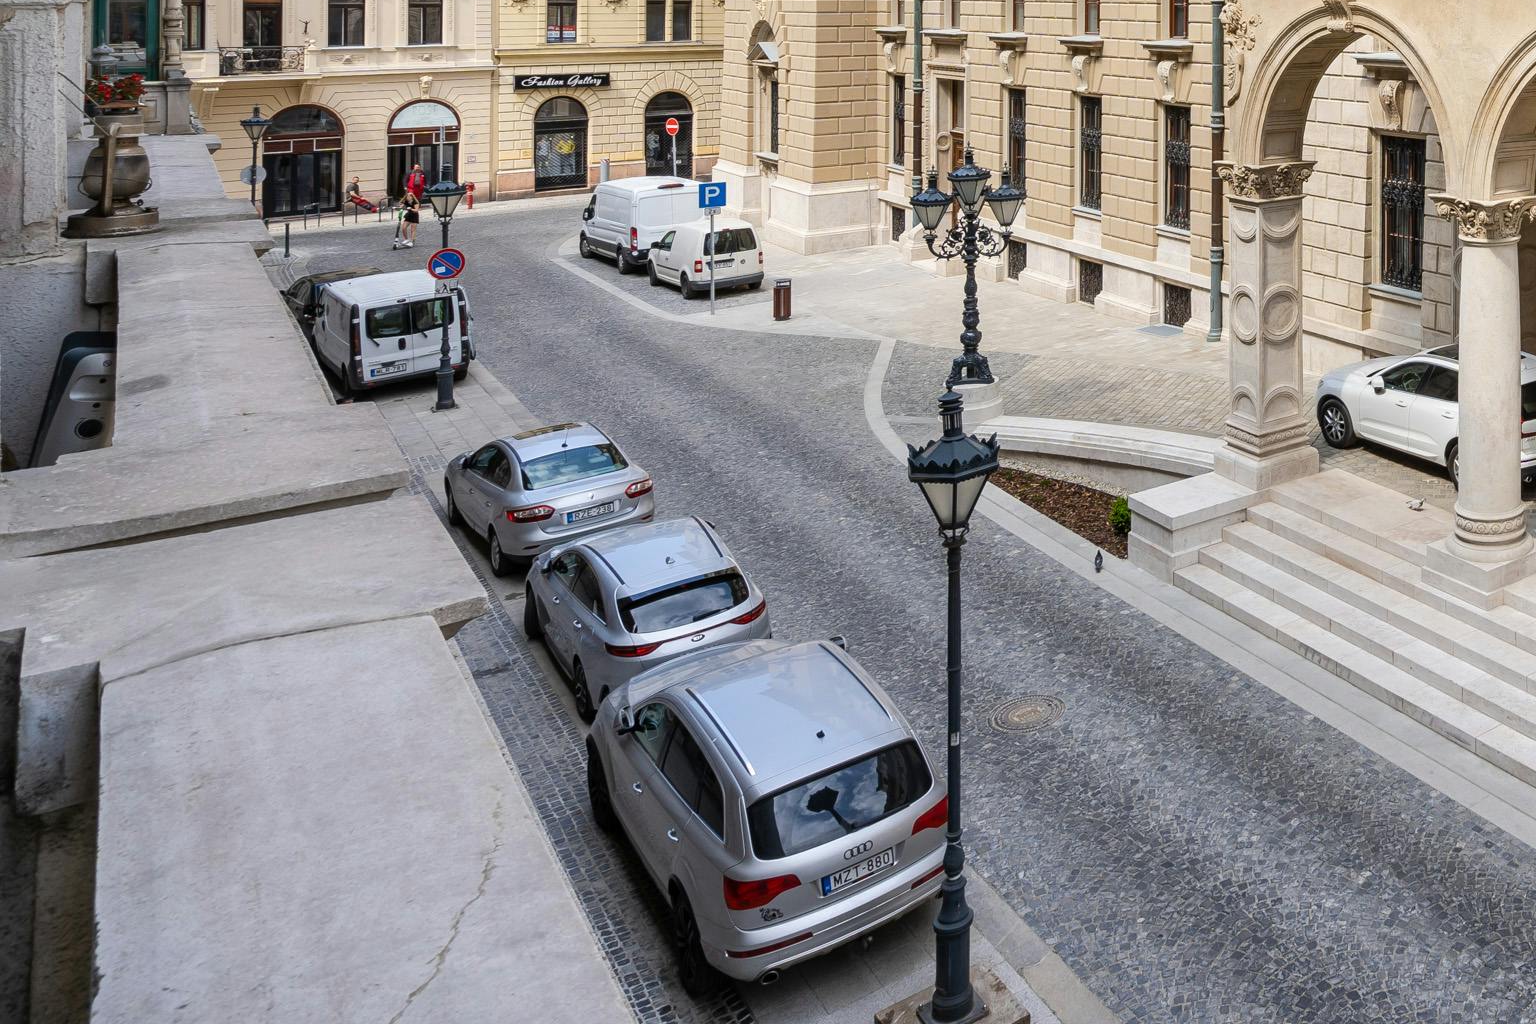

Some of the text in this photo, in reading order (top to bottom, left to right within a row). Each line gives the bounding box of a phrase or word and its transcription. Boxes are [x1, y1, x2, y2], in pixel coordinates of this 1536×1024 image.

[521, 75, 602, 87] Fashion Gallery
[705, 186, 720, 205] P
[833, 852, 890, 887] MZT-880
